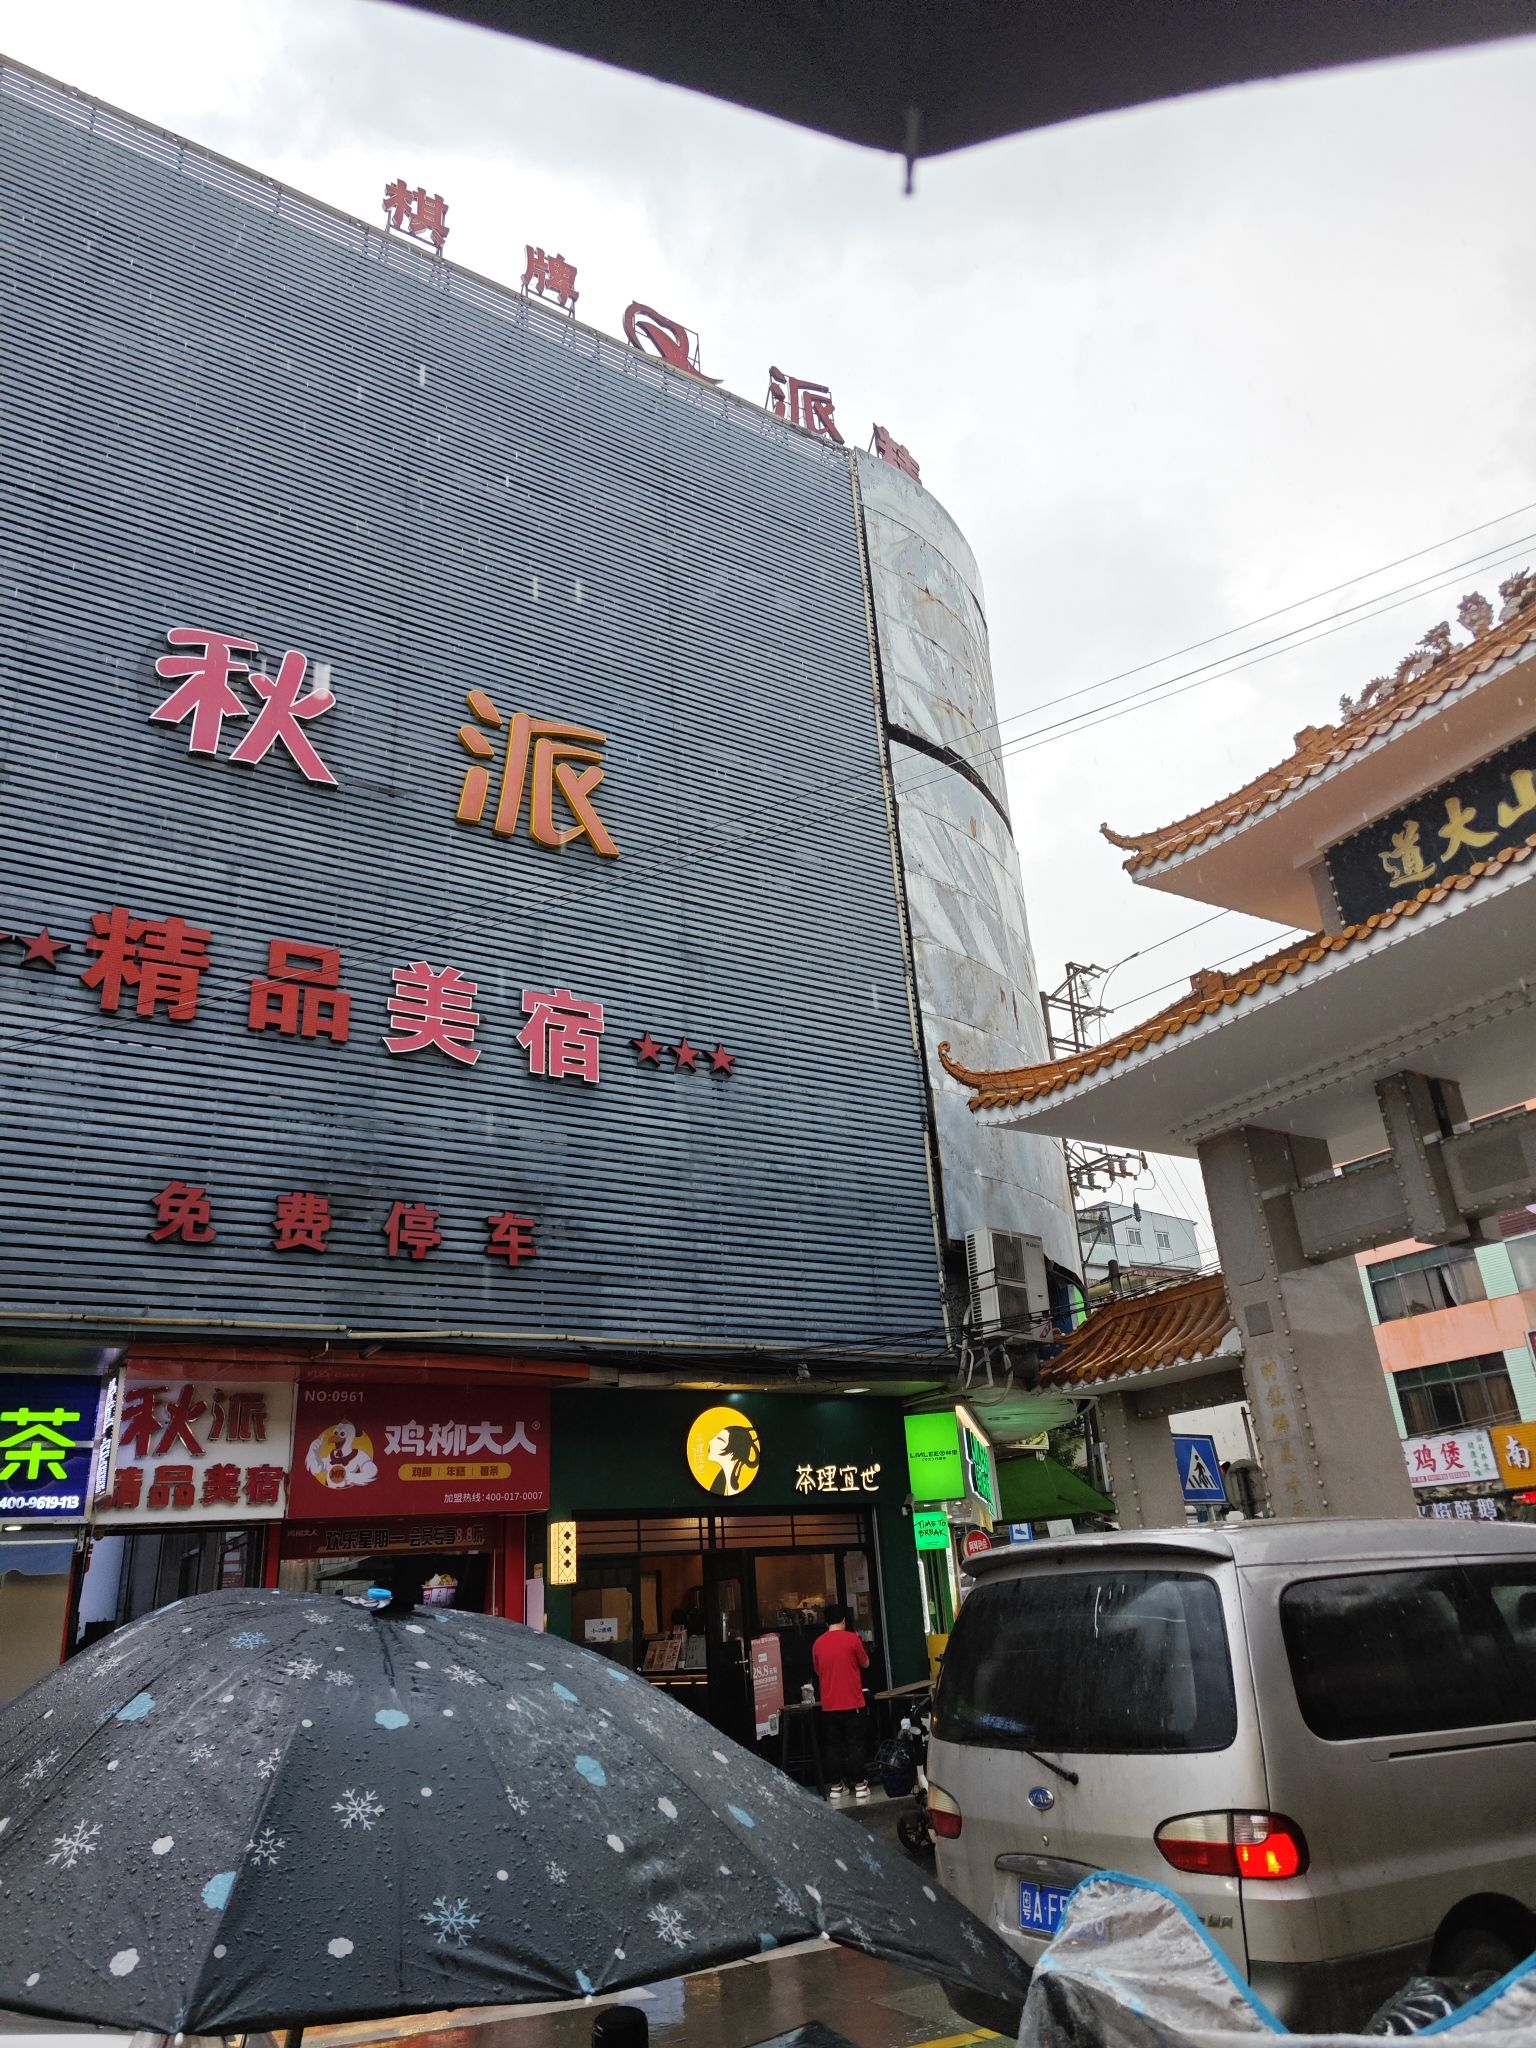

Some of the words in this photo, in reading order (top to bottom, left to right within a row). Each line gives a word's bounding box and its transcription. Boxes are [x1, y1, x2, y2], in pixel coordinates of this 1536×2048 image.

[148, 627, 621, 860] 秋派
[80, 905, 606, 1085] 精品美宿
[147, 1180, 537, 1267] 免费停车
[118, 1383, 268, 1459] 秋派
[304, 1390, 365, 1403] NO:0961
[0, 1407, 81, 1480] 茶
[383, 1419, 537, 1457] 鸡柳大人
[1403, 1440, 1465, 1473] 鸡煲
[795, 1463, 881, 1495] 茶理宜世
